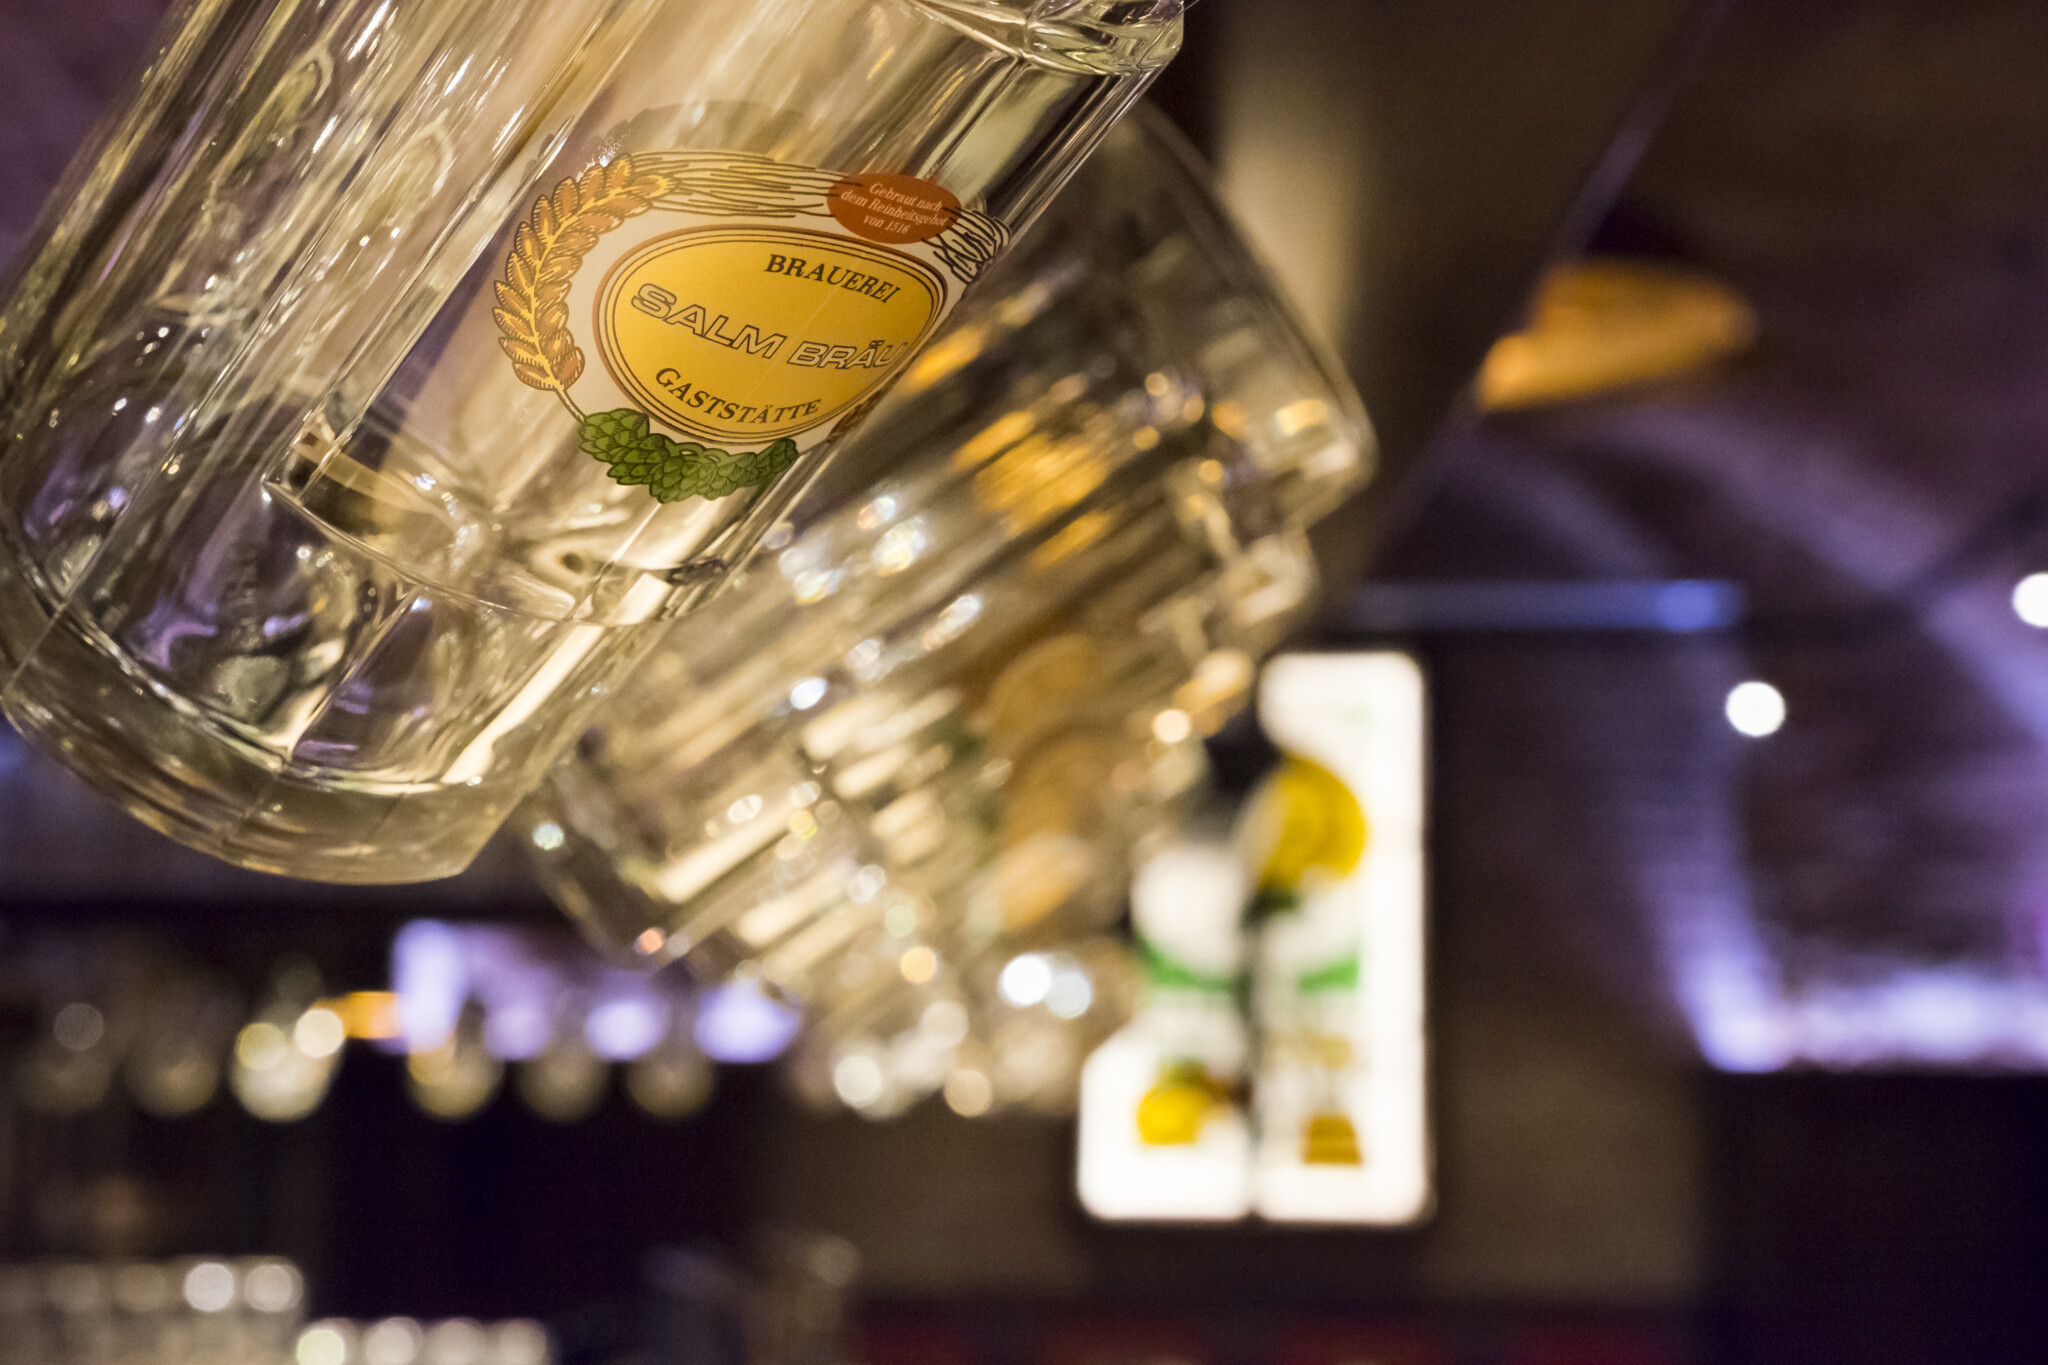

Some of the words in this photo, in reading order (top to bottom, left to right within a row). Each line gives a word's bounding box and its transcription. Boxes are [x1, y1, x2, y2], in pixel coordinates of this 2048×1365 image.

[841, 190, 868, 207] dem
[868, 198, 948, 226] Reinheitsgebot
[869, 182, 917, 206] Gebraut
[918, 198, 942, 212] nach
[864, 215, 884, 227] von
[884, 220, 911, 234] 1516
[763, 253, 902, 304] BRAUEREI
[630, 283, 787, 360] SALM
[787, 339, 908, 370] BRÄU
[655, 367, 821, 424] GASTSTÄTTE
